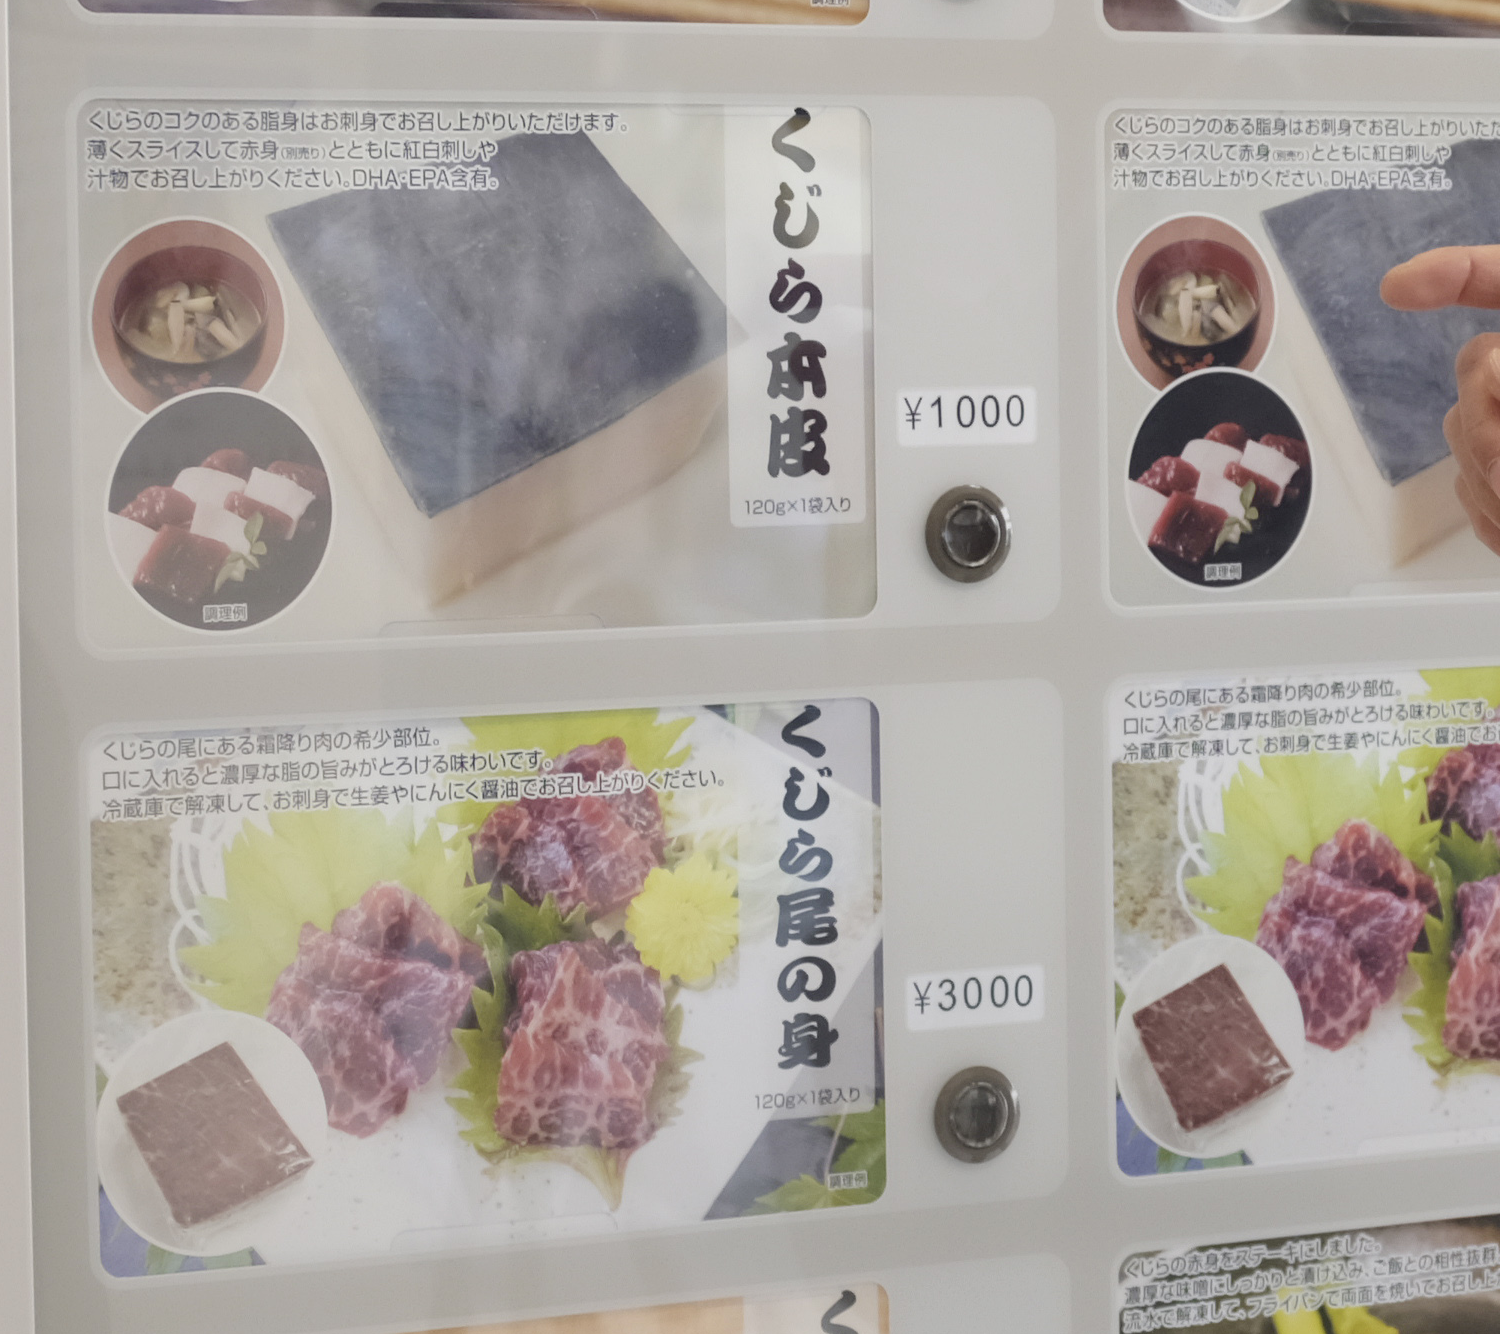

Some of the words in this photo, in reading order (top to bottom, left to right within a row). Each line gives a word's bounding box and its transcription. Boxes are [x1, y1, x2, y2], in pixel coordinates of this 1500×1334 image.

[903, 394, 1025, 430] ¥1000
[775, 704, 839, 1070] くじら尾の身
[912, 974, 1034, 1014] ¥3000
